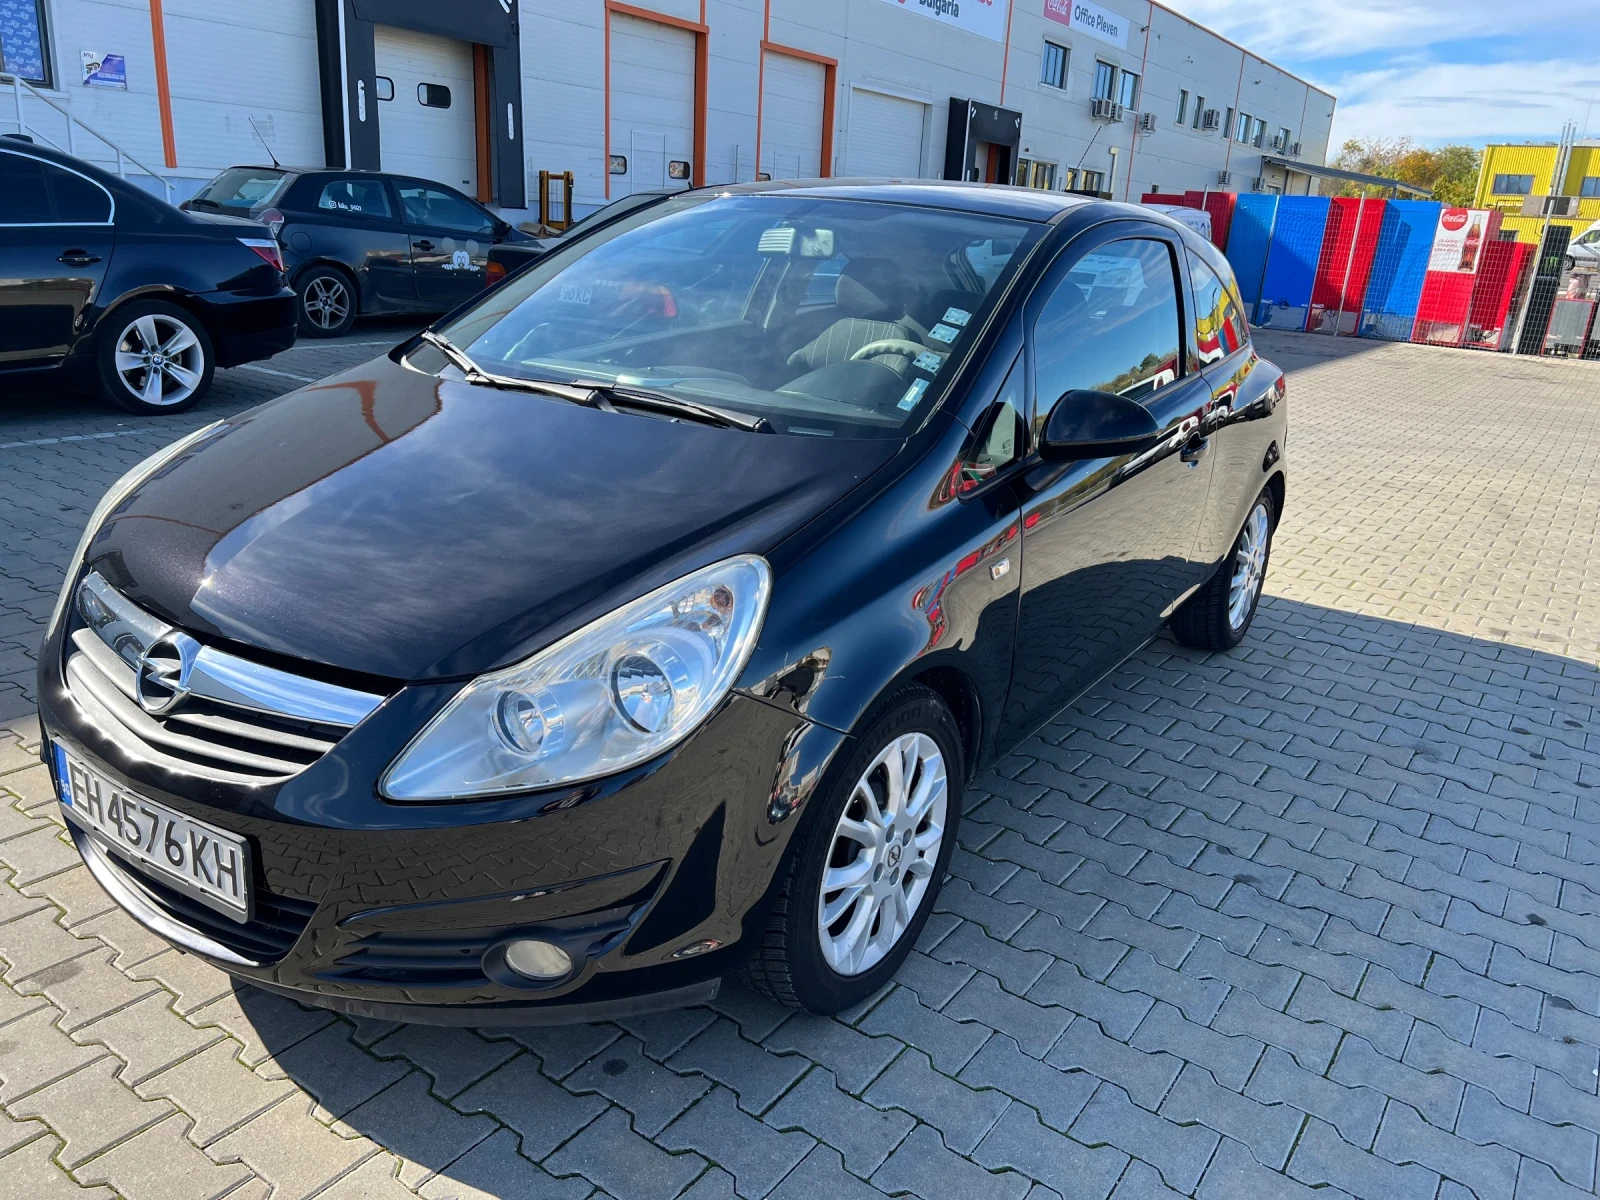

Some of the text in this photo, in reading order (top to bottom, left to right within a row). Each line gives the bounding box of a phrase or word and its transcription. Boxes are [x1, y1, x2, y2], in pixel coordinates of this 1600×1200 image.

[1074, 5, 1118, 37] Office Pleven
[1443, 213, 1468, 223] Coca-Cola
